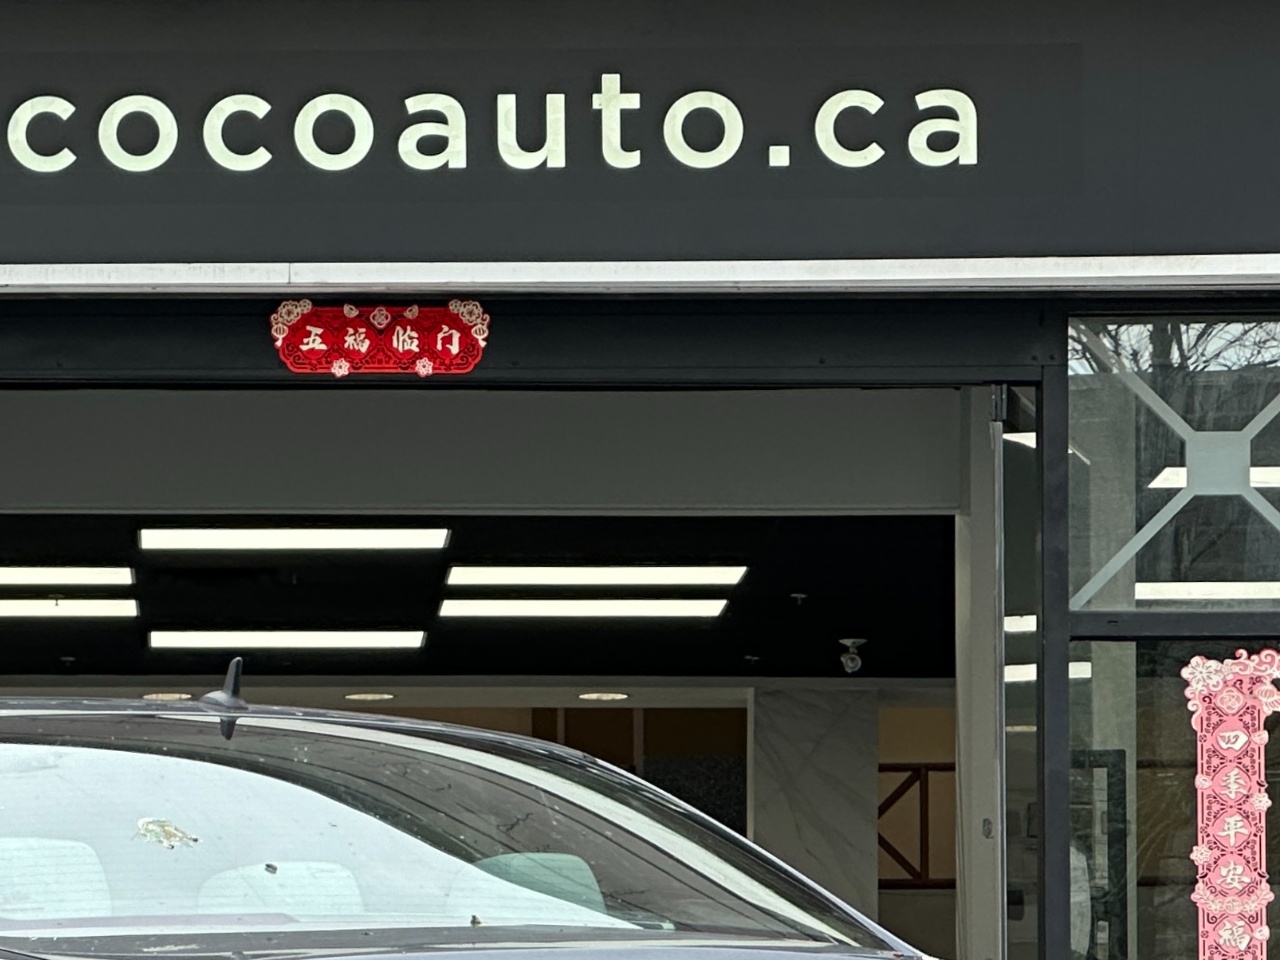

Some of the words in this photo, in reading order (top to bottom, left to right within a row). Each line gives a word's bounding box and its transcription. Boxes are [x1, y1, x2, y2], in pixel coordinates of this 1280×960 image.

[8, 74, 977, 172] cocoauto.ca
[299, 325, 461, 355] 五福临门
